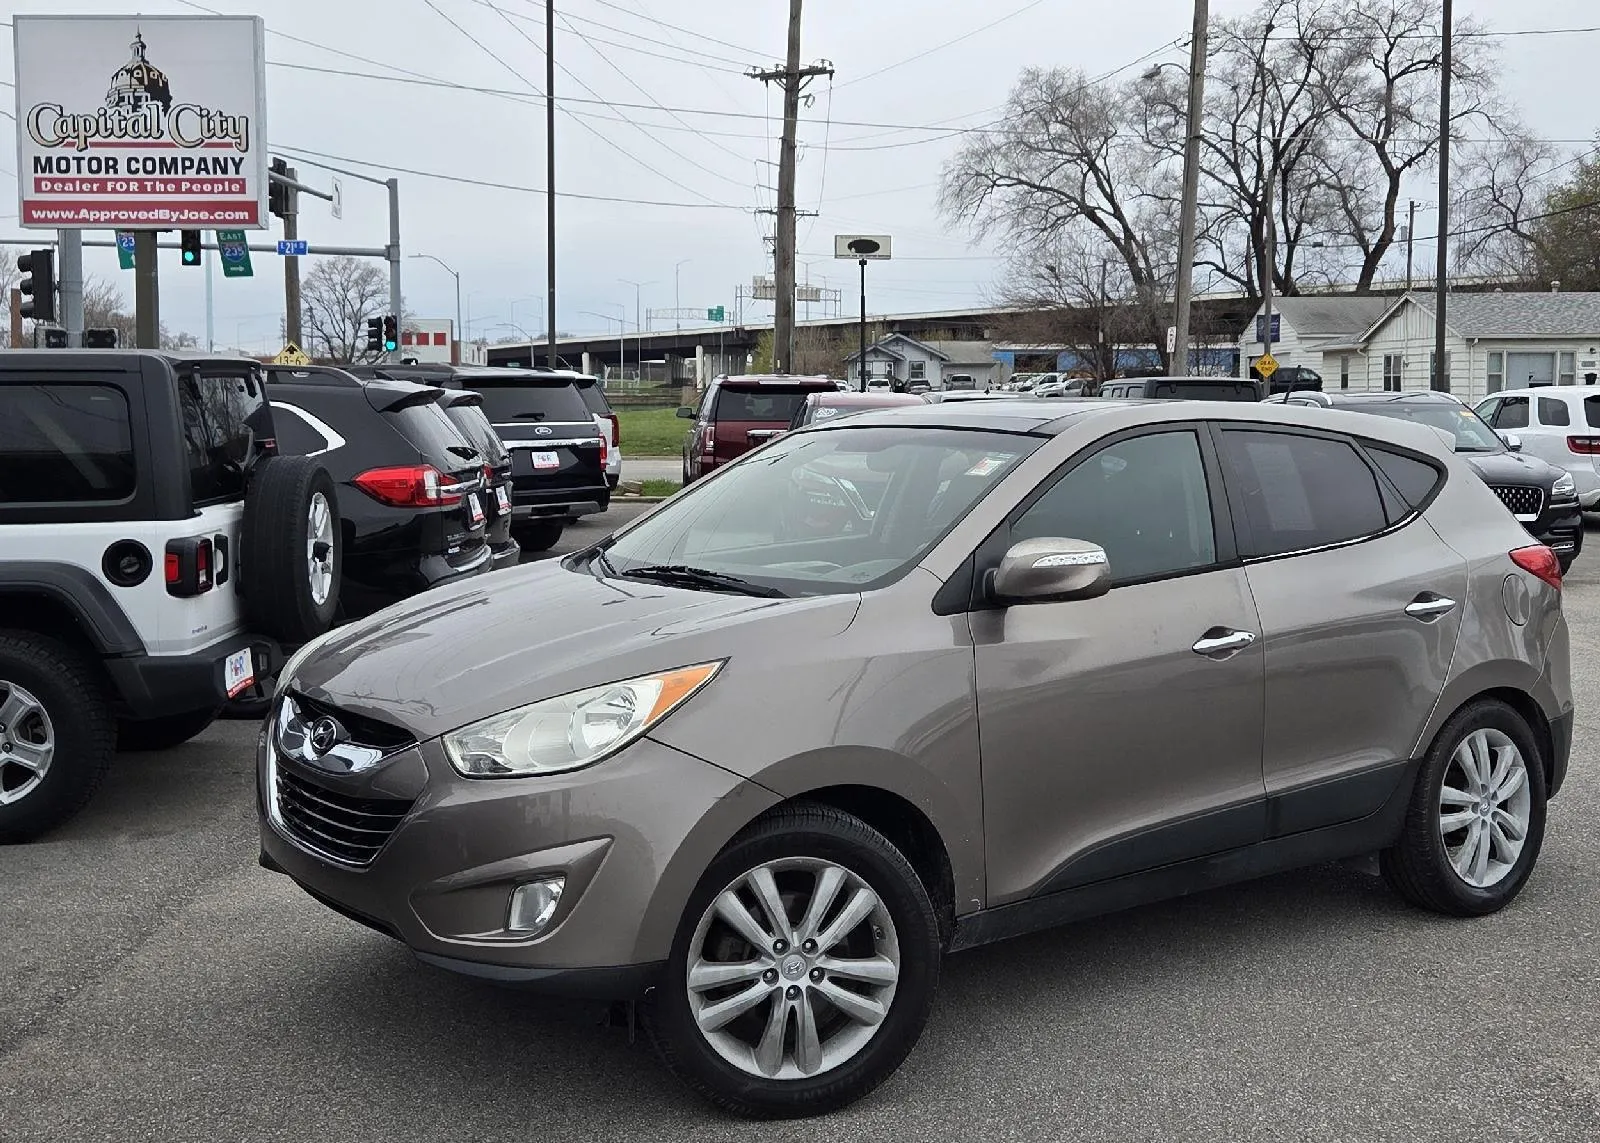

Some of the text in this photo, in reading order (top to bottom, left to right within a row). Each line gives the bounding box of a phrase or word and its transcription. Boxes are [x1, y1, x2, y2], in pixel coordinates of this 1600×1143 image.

[27, 102, 249, 153] Capital City
[33, 156, 245, 175] MOTOR COMPANY
[41, 180, 100, 192] Dealer
[106, 181, 139, 192] FOR
[144, 181, 176, 192] The
[31, 208, 249, 222] www.ApprovedByJoe.com
[122, 236, 135, 247] 23
[219, 232, 242, 240] EAST
[224, 246, 245, 257] 235
